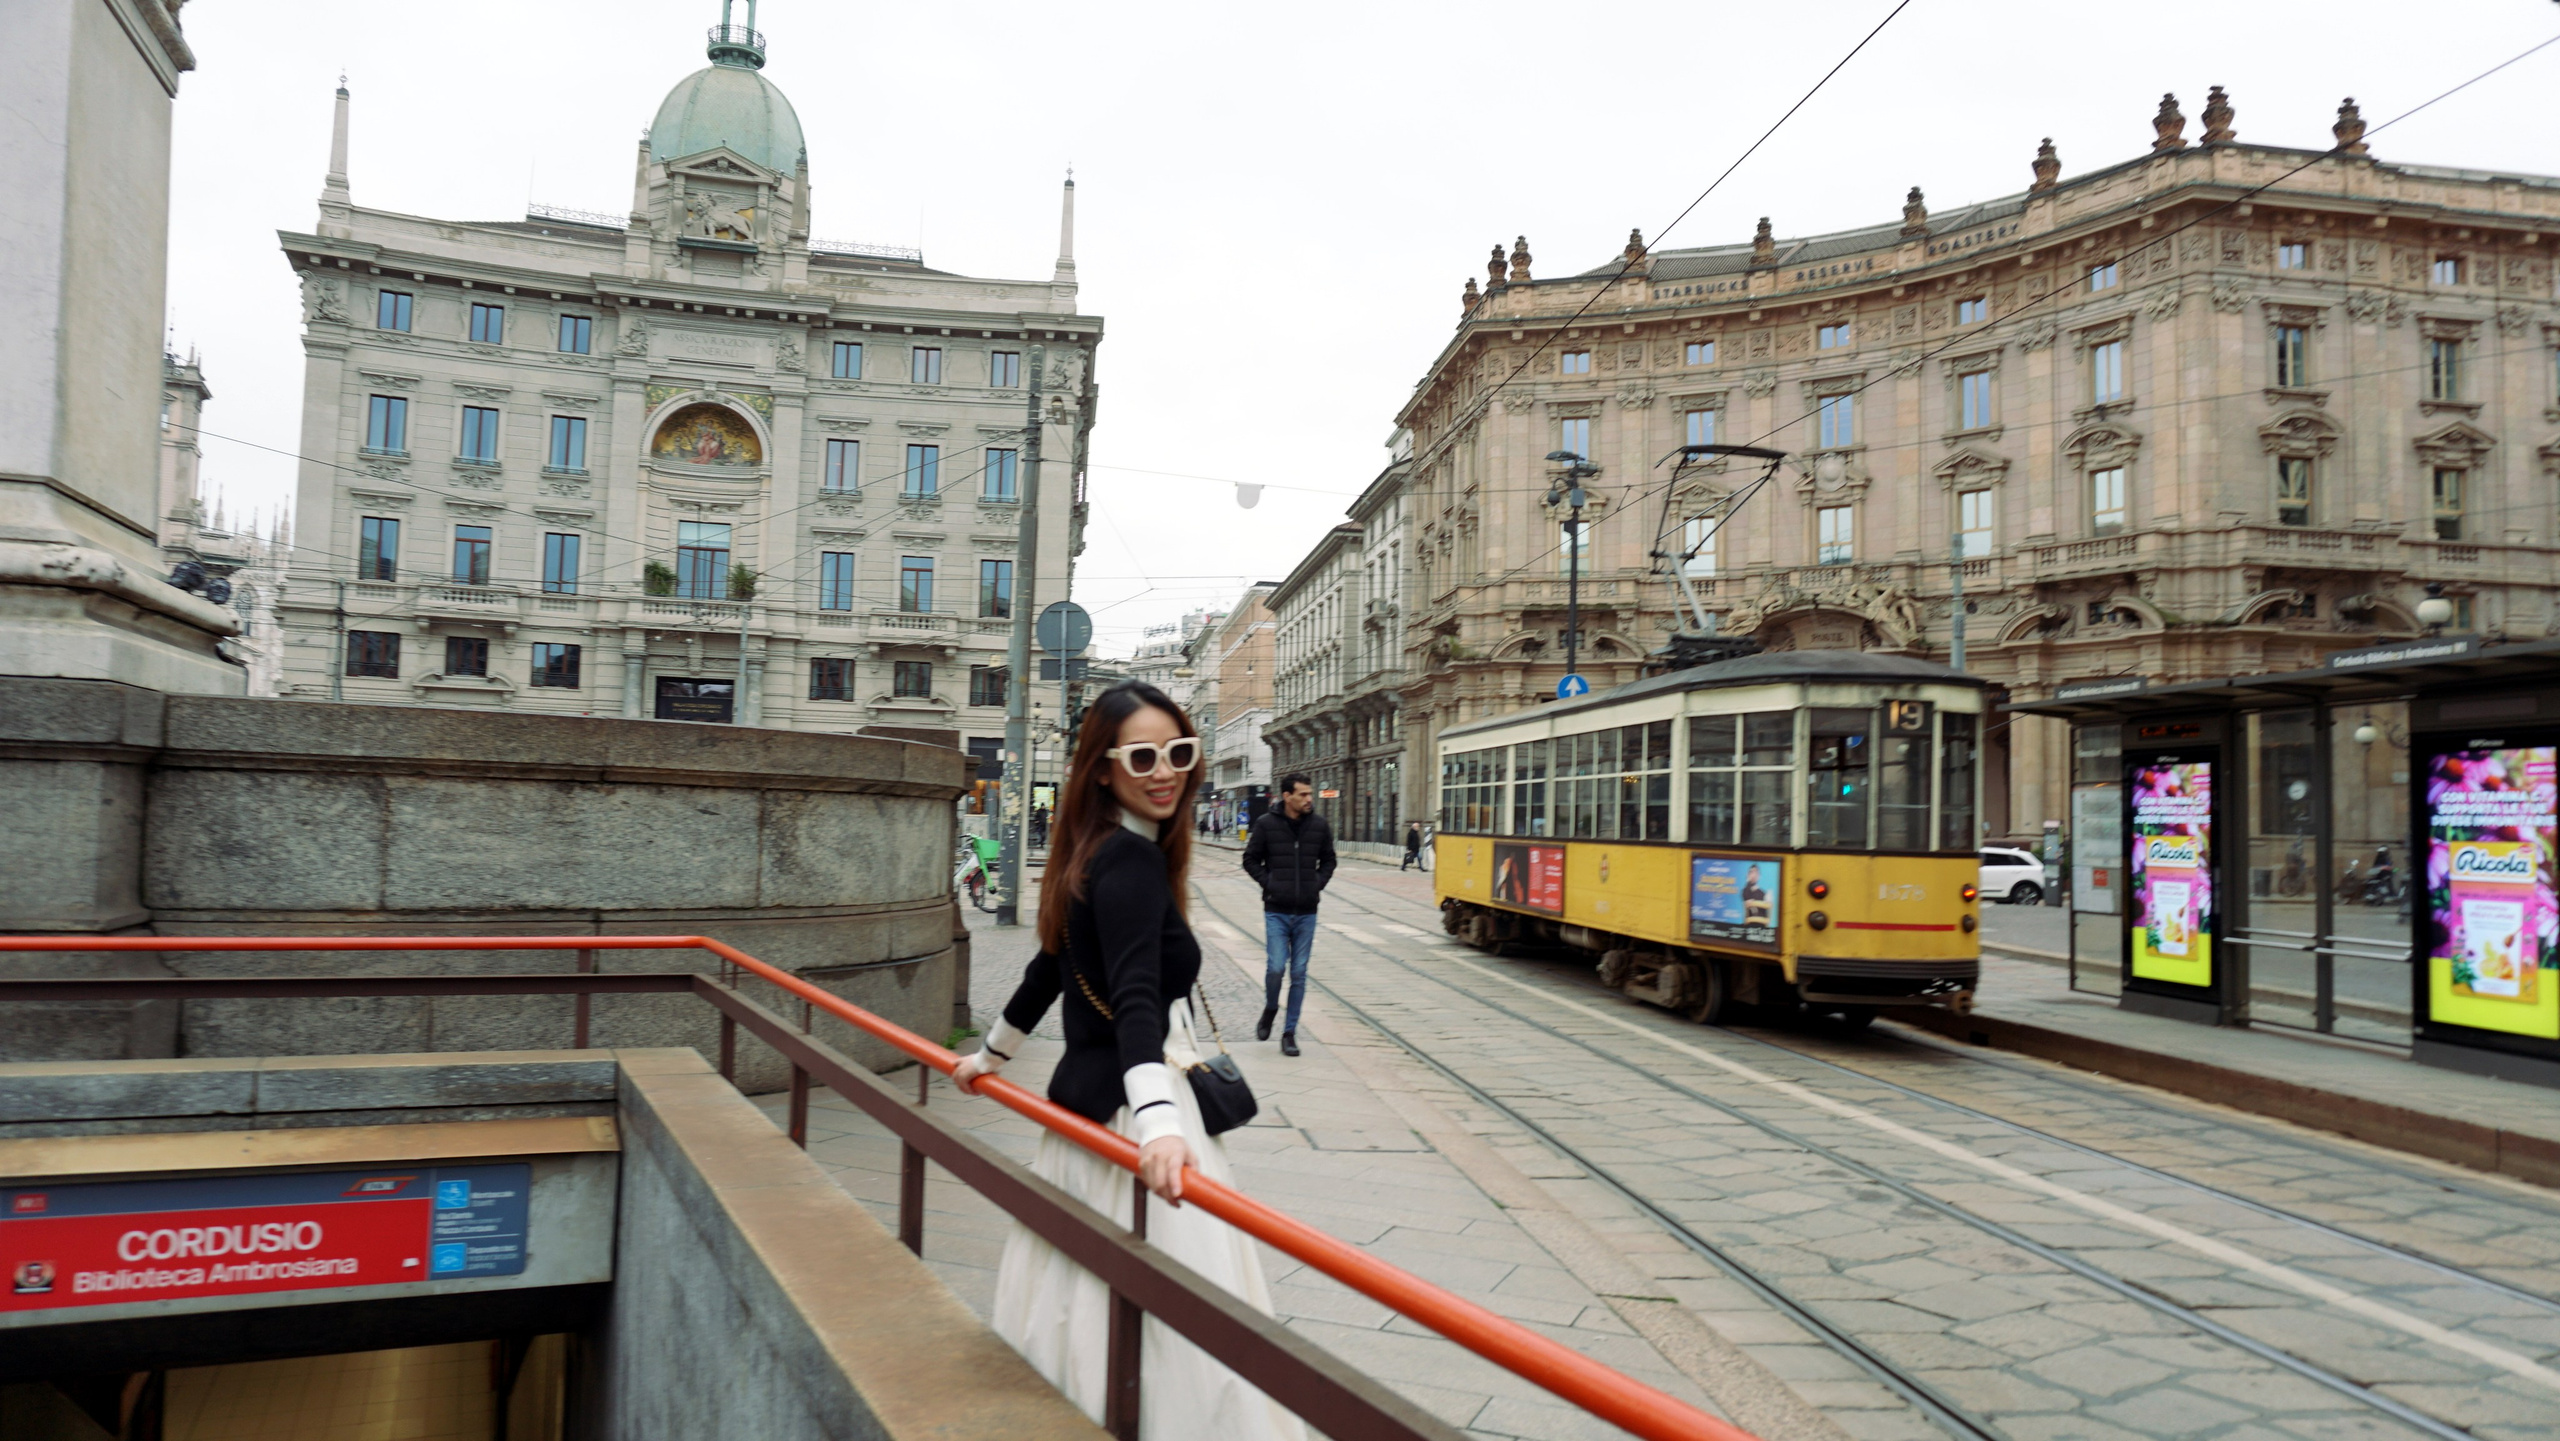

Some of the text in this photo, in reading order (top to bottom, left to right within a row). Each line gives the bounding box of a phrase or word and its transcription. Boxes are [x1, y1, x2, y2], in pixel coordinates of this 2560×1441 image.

[1653, 222, 2020, 300] STARBUCKS RESERVE ROASTERY
[686, 345, 741, 359] GENERALI
[1889, 700, 1925, 731] 19
[2440, 791, 2466, 802] CON
[2468, 791, 2529, 802] VITAMINA
[2438, 803, 2502, 815] SUPPORTA
[2503, 803, 2520, 814] LE
[2431, 814, 2557, 826] DIFESE IMMUNITARIE
[2149, 842, 2194, 861] Ricola
[2456, 850, 2528, 873] Ricola
[117, 1220, 323, 1262] CORDUSIO
[72, 1257, 359, 1293] Biblioteca Ambrosiana
